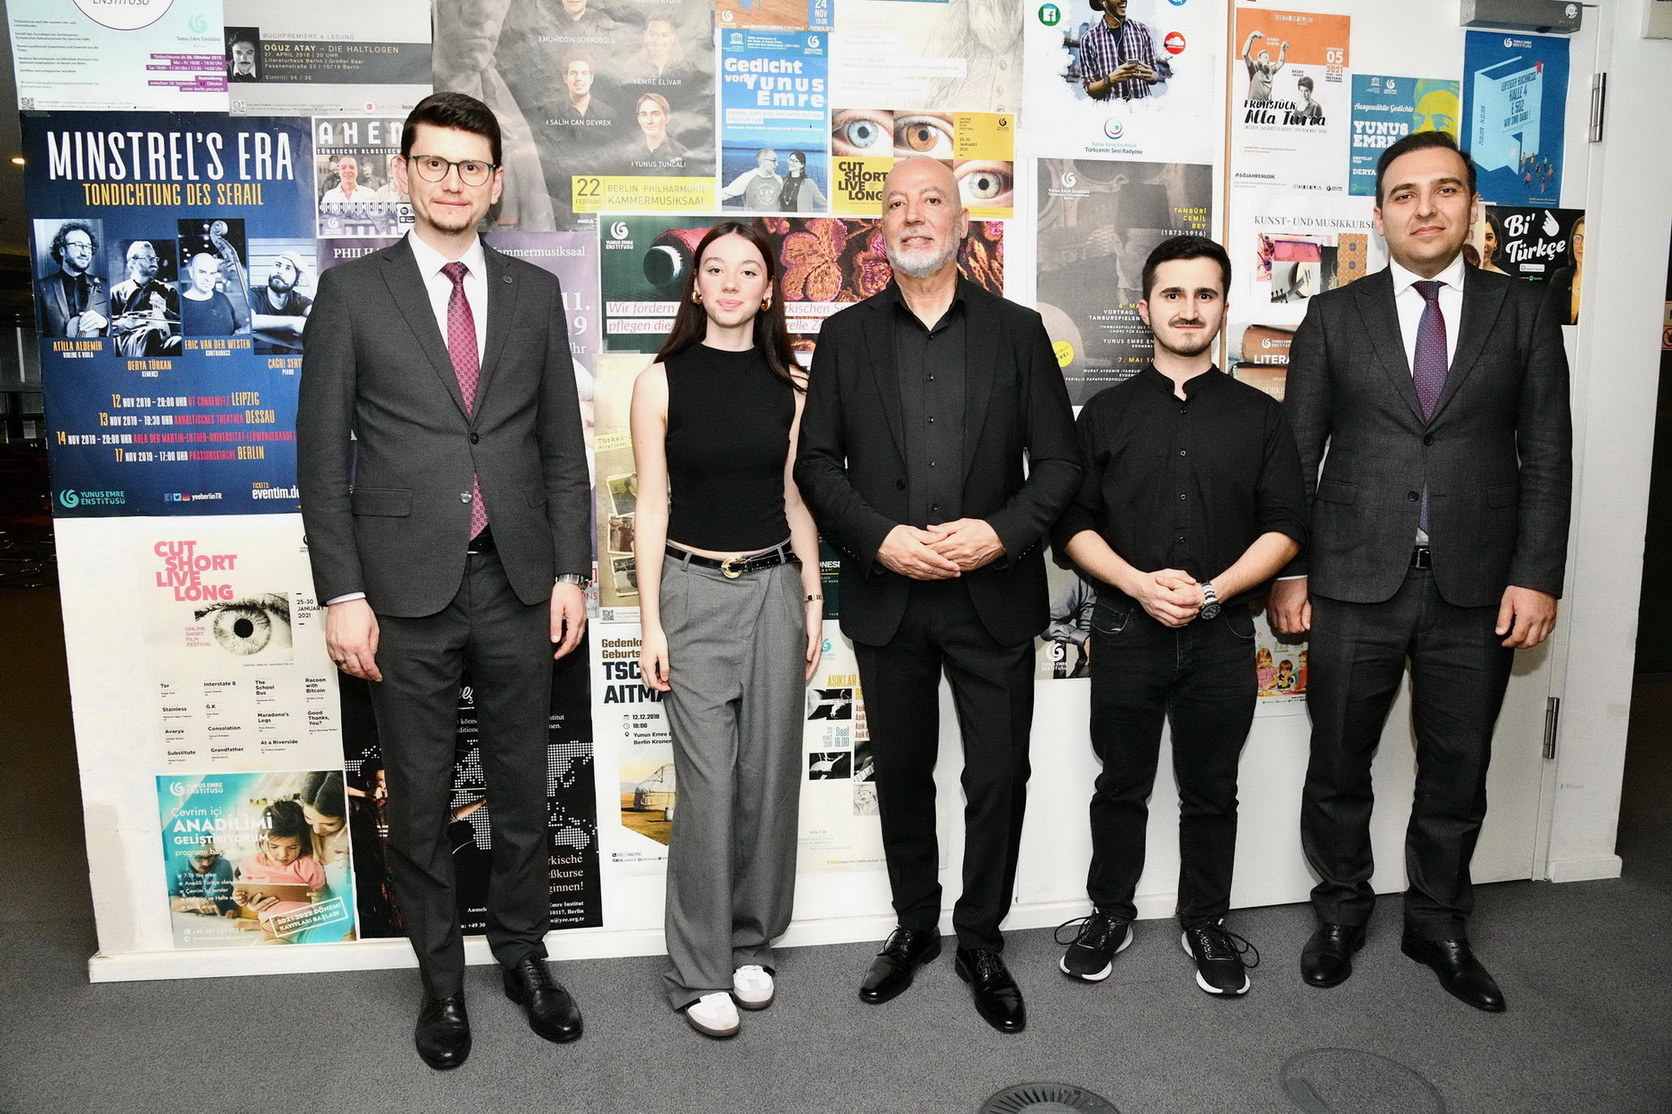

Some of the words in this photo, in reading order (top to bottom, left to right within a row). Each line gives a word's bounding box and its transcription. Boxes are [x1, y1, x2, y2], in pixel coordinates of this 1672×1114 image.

[264, 43, 290, 52] OĞUZ
[1326, 50, 1344, 64] 05
[724, 58, 802, 74] Gedicht
[743, 74, 824, 92] Yunus
[757, 90, 824, 107] Emre
[1354, 103, 1389, 112] Ausgewählte
[1390, 104, 1414, 113] Gedichte
[1244, 109, 1276, 124] Alla
[1353, 121, 1408, 135] YUNUS
[1353, 135, 1396, 148] EMRE
[47, 131, 224, 180] MINSTREL'S
[238, 132, 294, 180] ERA
[839, 162, 864, 173] CUT
[844, 172, 888, 182] SHORT
[577, 178, 600, 196] 22
[608, 185, 638, 193] BERLIN
[838, 181, 866, 191] LIVE
[83, 183, 181, 206] TONDICHTUNG
[187, 184, 211, 205] DES
[217, 184, 264, 206] SERAIL
[849, 191, 883, 200] LONG
[1254, 216, 1291, 225] KUNST-
[1293, 217, 1314, 226] UND
[1315, 219, 1376, 229] MUSIKKURSE
[493, 246, 585, 257] ammermusiksaal
[1505, 238, 1566, 263] Türkçe
[609, 303, 630, 314] Wir
[632, 302, 674, 314] fördern
[609, 320, 651, 333] pflegen
[654, 320, 670, 331] die
[53, 340, 74, 351] ATİLLA
[76, 340, 103, 351] ALDEMİR
[184, 340, 198, 349] ERIC
[200, 340, 212, 349] VAN
[214, 340, 226, 349] DER
[227, 339, 251, 349] WESTEN
[127, 360, 146, 370] DERYA
[148, 359, 172, 370] TÜRKAN
[112, 394, 121, 408] 12
[122, 398, 134, 407] NOV
[136, 397, 151, 407] 2019
[157, 397, 174, 407] 20:00
[175, 397, 187, 407] UHR
[232, 392, 260, 406] LEIPZIG
[99, 412, 108, 426] 13
[109, 416, 121, 426] NOV
[122, 416, 138, 426] 2019
[161, 415, 173, 425] UHR
[245, 410, 275, 424] DESSAU
[57, 431, 66, 445] 14
[68, 435, 80, 445] NOV
[81, 434, 96, 445] 2019
[102, 434, 119, 444] 20:00
[121, 434, 132, 444] UHR
[115, 448, 123, 462] 17
[125, 452, 137, 462] NOV
[138, 452, 153, 462] 2019
[160, 451, 175, 461] 17:00
[176, 451, 188, 461] UHR
[237, 446, 265, 460] BERLIN
[192, 493, 222, 502] yeeberlinTR
[154, 540, 196, 557] CUT
[165, 554, 237, 571] SHORT
[156, 570, 201, 587] LIVE
[174, 584, 234, 602] LONG
[602, 650, 641, 659] Geburts
[602, 661, 641, 680] TSC
[835, 737, 849, 747] 18.00
[172, 807, 207, 819] Çevrim
[210, 807, 222, 817] içi
[173, 812, 272, 832] ANADİLİMİ
